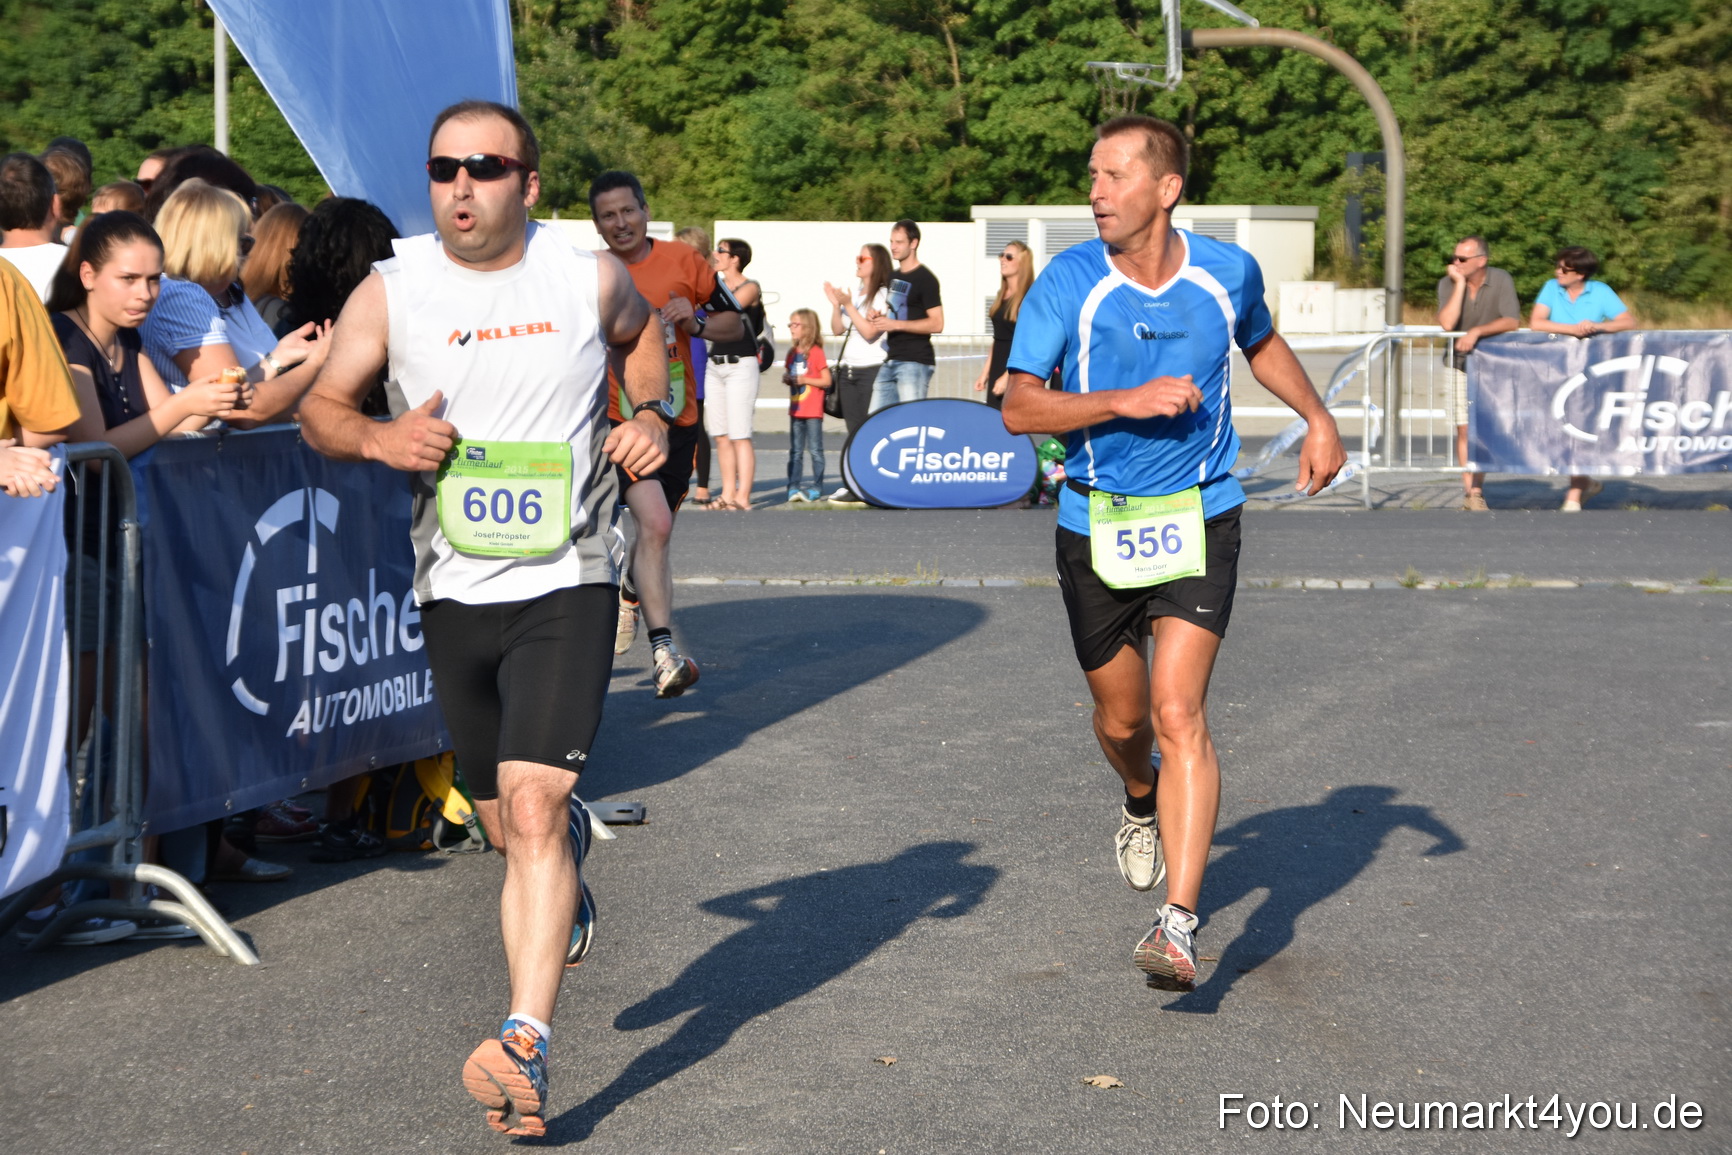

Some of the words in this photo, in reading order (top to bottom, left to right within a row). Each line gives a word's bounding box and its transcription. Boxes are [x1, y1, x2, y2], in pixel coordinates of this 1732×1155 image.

[476, 321, 561, 341] KLEBL
[1157, 329, 1189, 340] classic
[898, 446, 1015, 472] Fischer
[910, 471, 1008, 484] AUTOMOBILE
[463, 486, 543, 525] 606
[473, 530, 495, 539] Josef
[1116, 523, 1183, 561] 556
[1134, 565, 1152, 573] Hans
[285, 668, 433, 738] AUTOMOBILE
